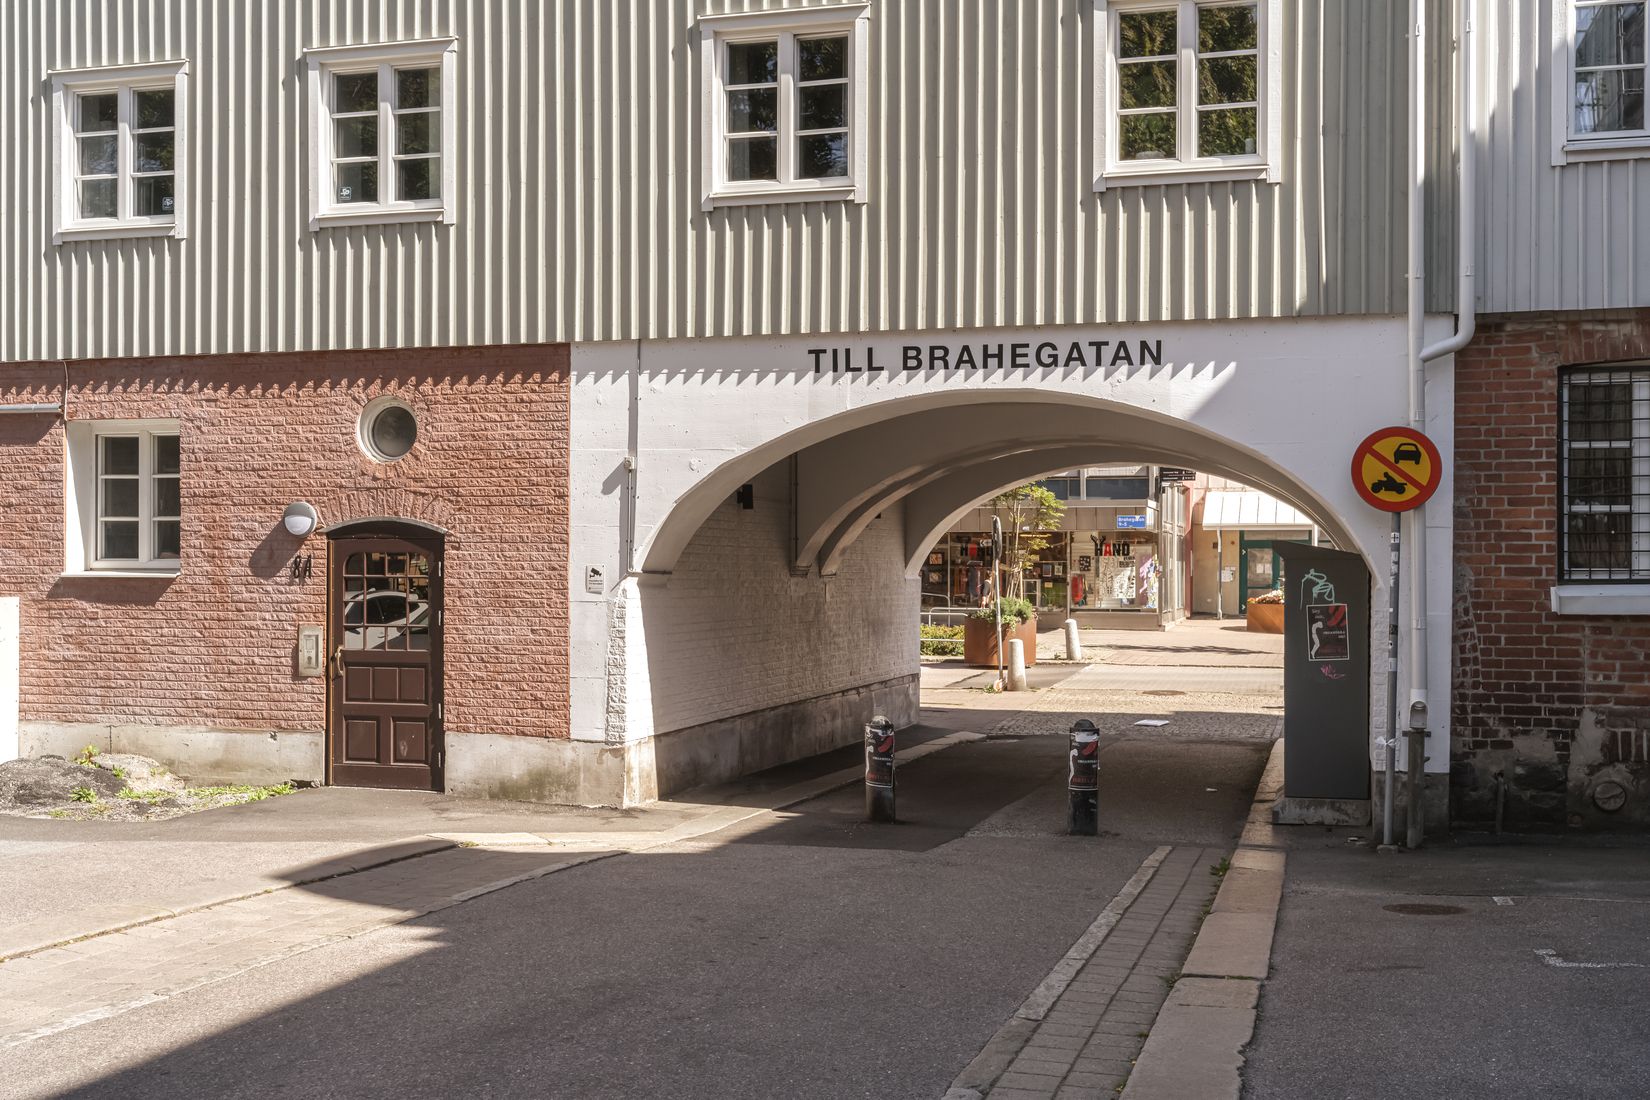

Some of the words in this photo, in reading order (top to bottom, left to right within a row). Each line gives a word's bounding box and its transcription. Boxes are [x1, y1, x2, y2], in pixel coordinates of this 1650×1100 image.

[807, 347, 885, 374] TILL
[902, 339, 1162, 371] BRAHEGATAN
[1090, 534, 1131, 557] HAND
[293, 554, 312, 579] 8A
